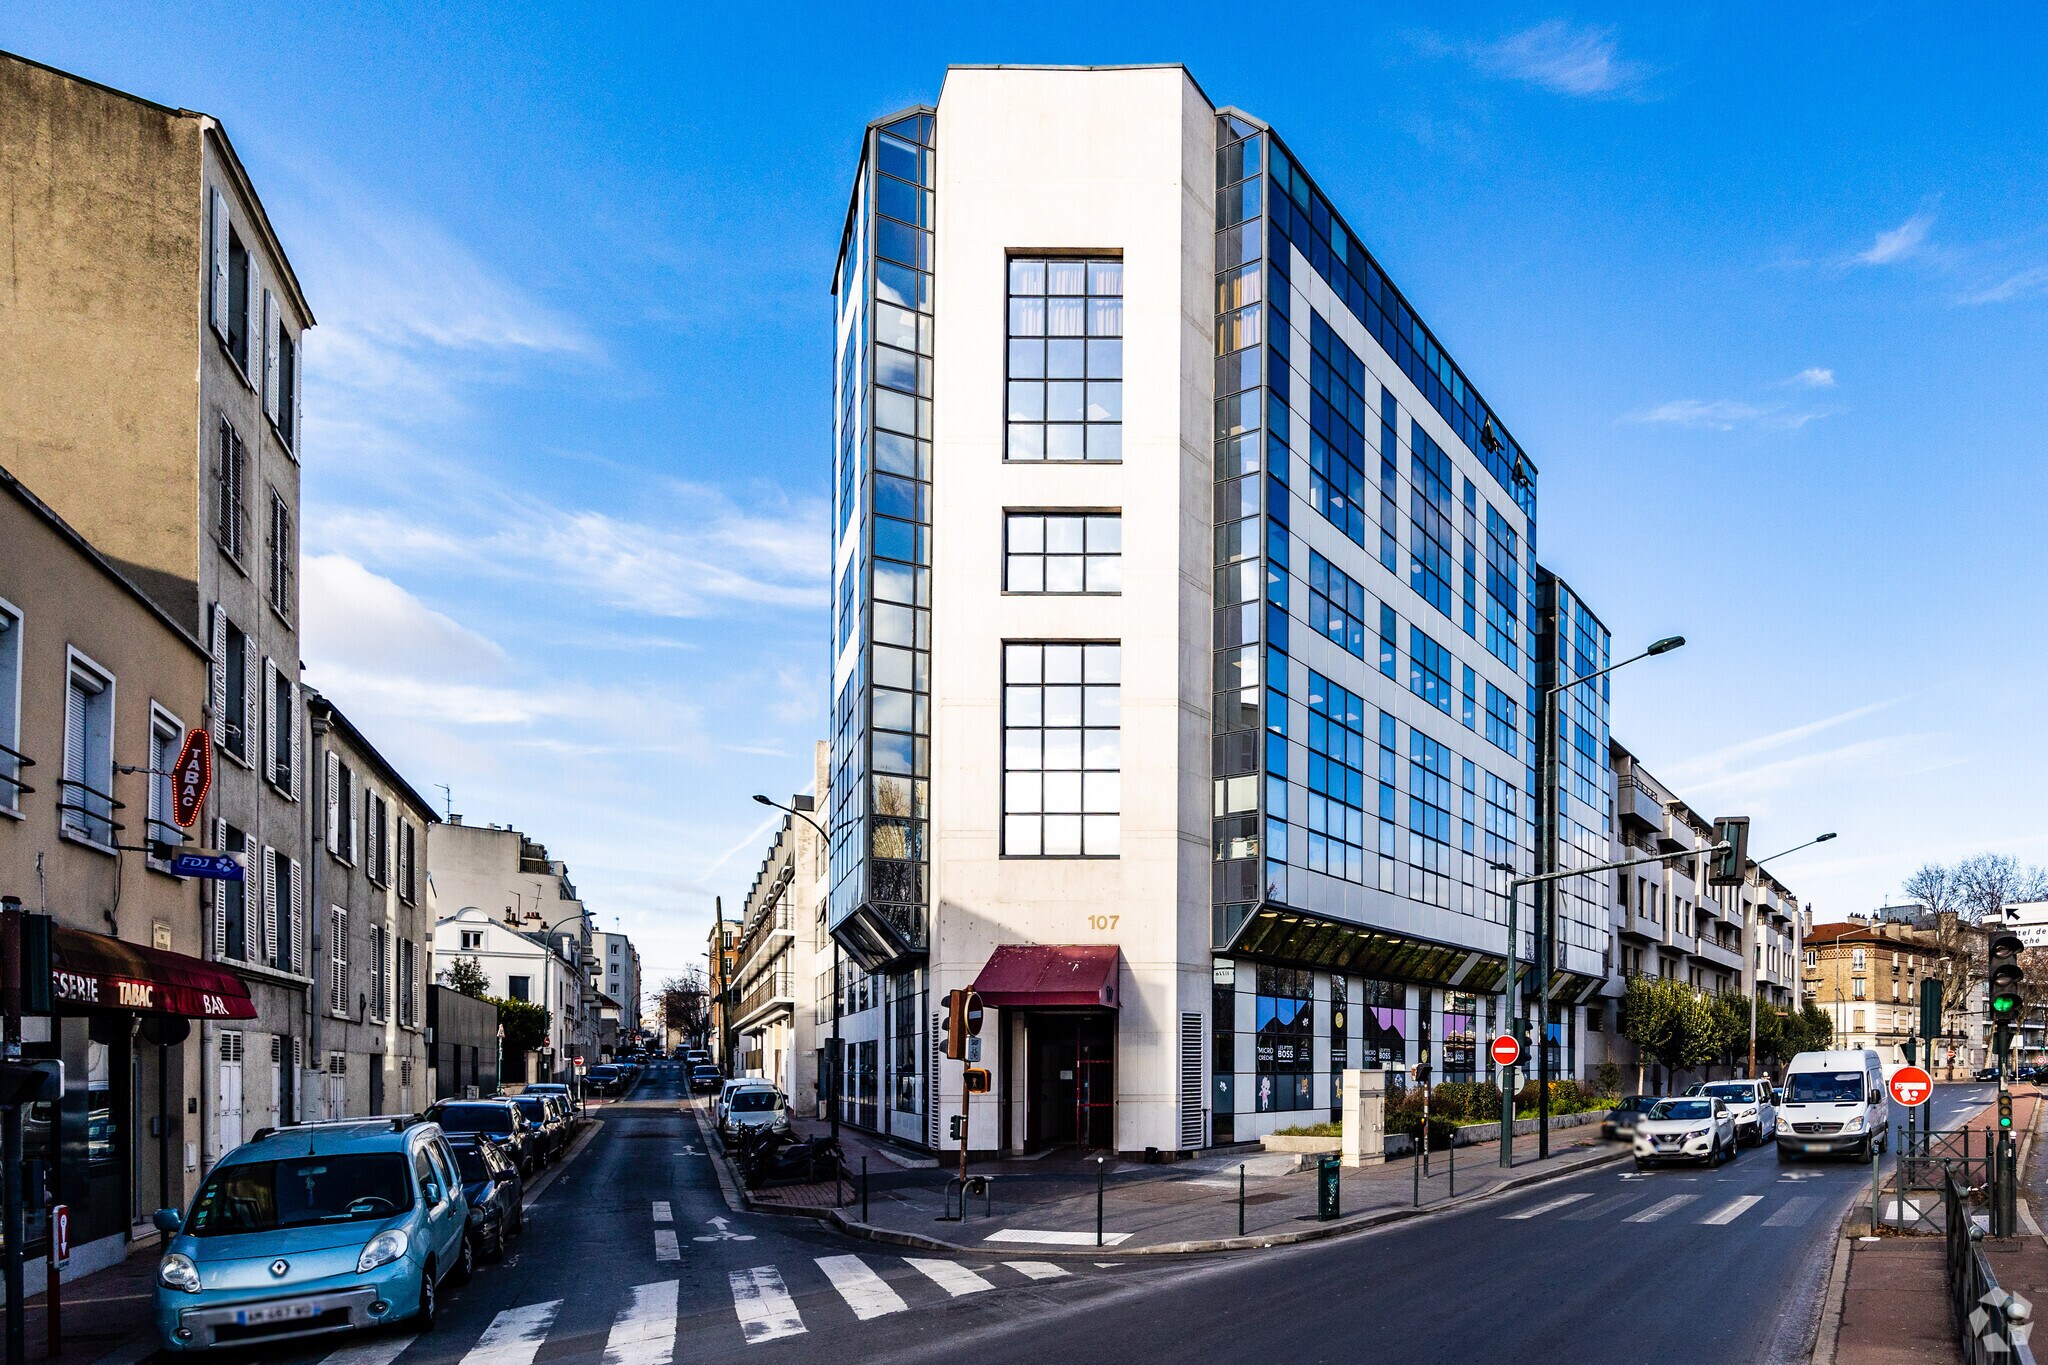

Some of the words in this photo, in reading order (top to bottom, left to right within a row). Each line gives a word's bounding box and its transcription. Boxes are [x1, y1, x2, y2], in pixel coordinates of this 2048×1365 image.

[182, 748, 201, 807] TABAC
[181, 856, 210, 868] FDJ
[1088, 915, 1120, 930] 107
[52, 971, 99, 1003] SSERIE
[118, 982, 154, 1008] TABAC
[202, 994, 230, 1015] BAR
[1277, 1050, 1294, 1058] BOSS
